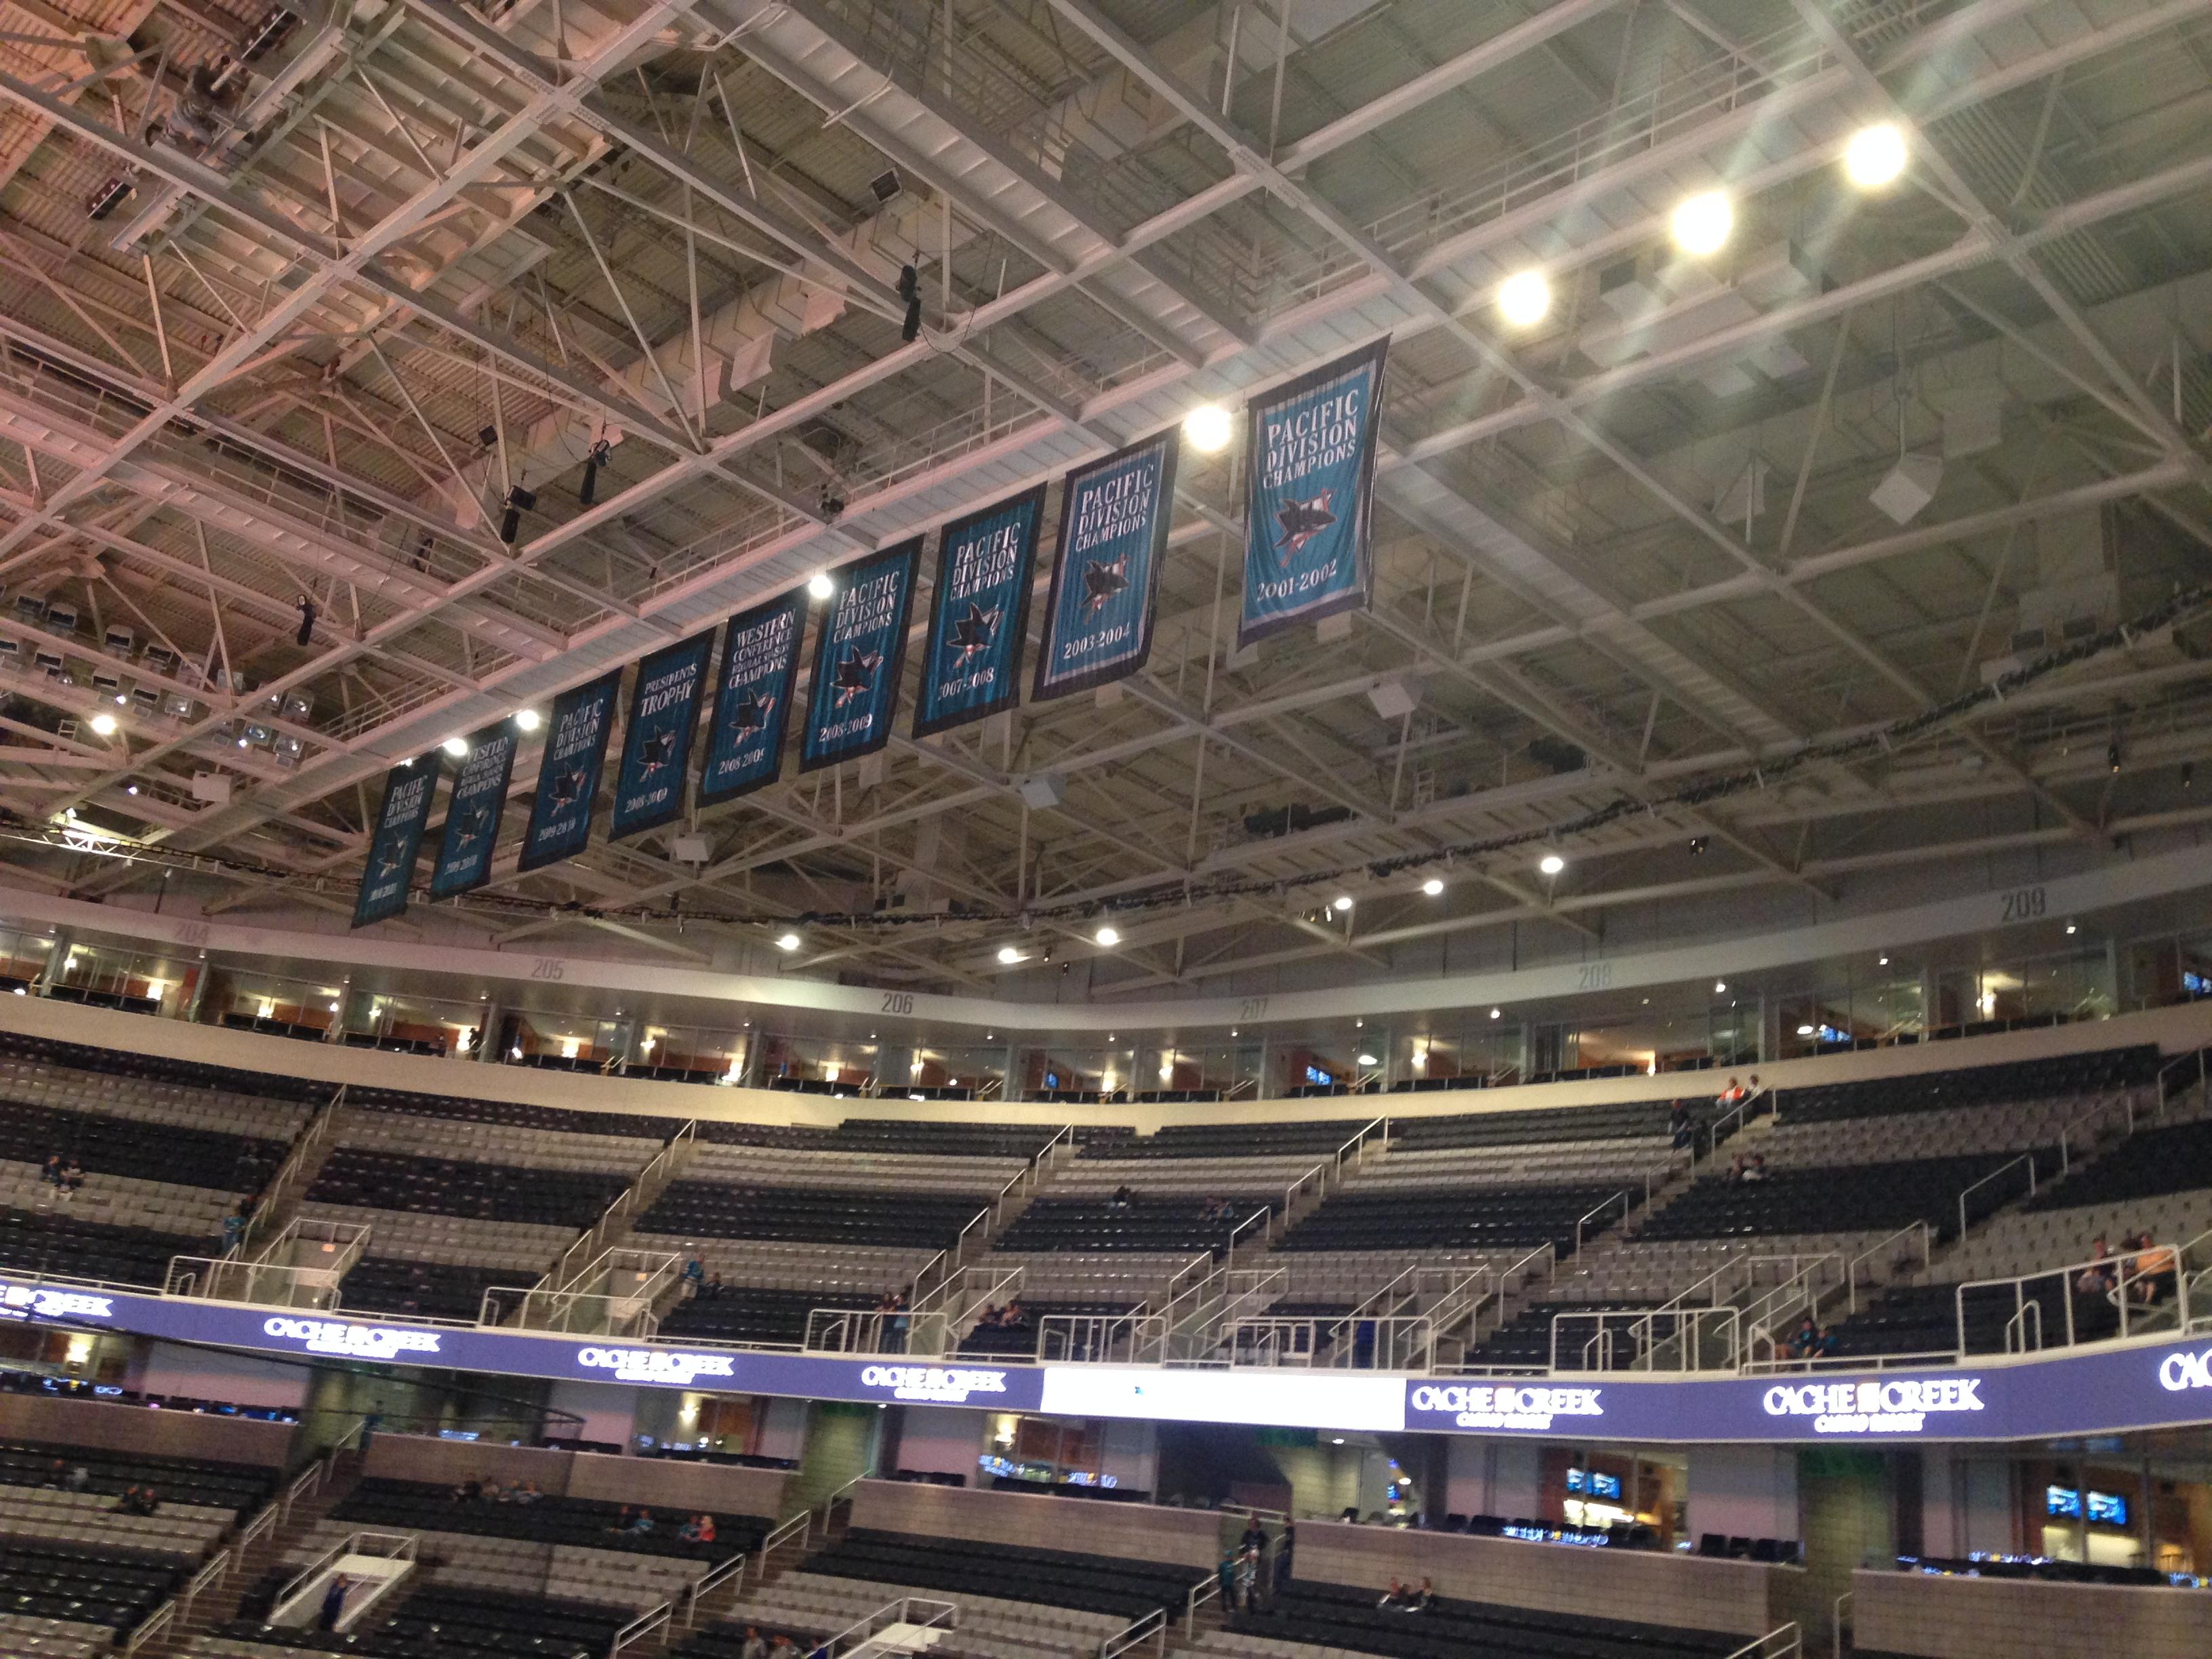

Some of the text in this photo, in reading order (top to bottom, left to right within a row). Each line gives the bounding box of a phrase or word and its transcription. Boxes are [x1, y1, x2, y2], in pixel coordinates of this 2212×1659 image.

[1267, 389, 1359, 448] PACIFIC
[1267, 415, 1356, 472] DIVISION
[1263, 439, 1355, 489] CHAMPIONS
[1081, 463, 1154, 514] PACIFIC
[1078, 489, 1151, 535] DIVISION
[956, 523, 1021, 567] PACIFIC
[1076, 511, 1147, 552] CHAMPIONS
[951, 565, 1015, 601] CHAMPIONS
[953, 546, 1018, 586] DIVISION
[1257, 558, 1337, 601] 2001-2002
[840, 571, 899, 611] PACIFIC
[737, 609, 796, 647] WESTERN
[836, 592, 897, 630] DIVISION
[733, 628, 792, 663] CONFERENCE
[1063, 621, 1130, 659] 2003-2004
[729, 655, 787, 689] CHAMPIONS
[560, 698, 604, 733] PACIFIC
[640, 679, 695, 717] TROPHY
[556, 718, 600, 749] DIVISION
[2001, 886, 2046, 922] 209
[531, 959, 565, 980] 205
[1578, 962, 1612, 991] 208
[881, 992, 914, 1015] 206
[1240, 998, 1268, 1020] 207
[1412, 1386, 1604, 1415] CACHE CREEK
[1763, 1378, 1985, 1415] CACHE CREEK
